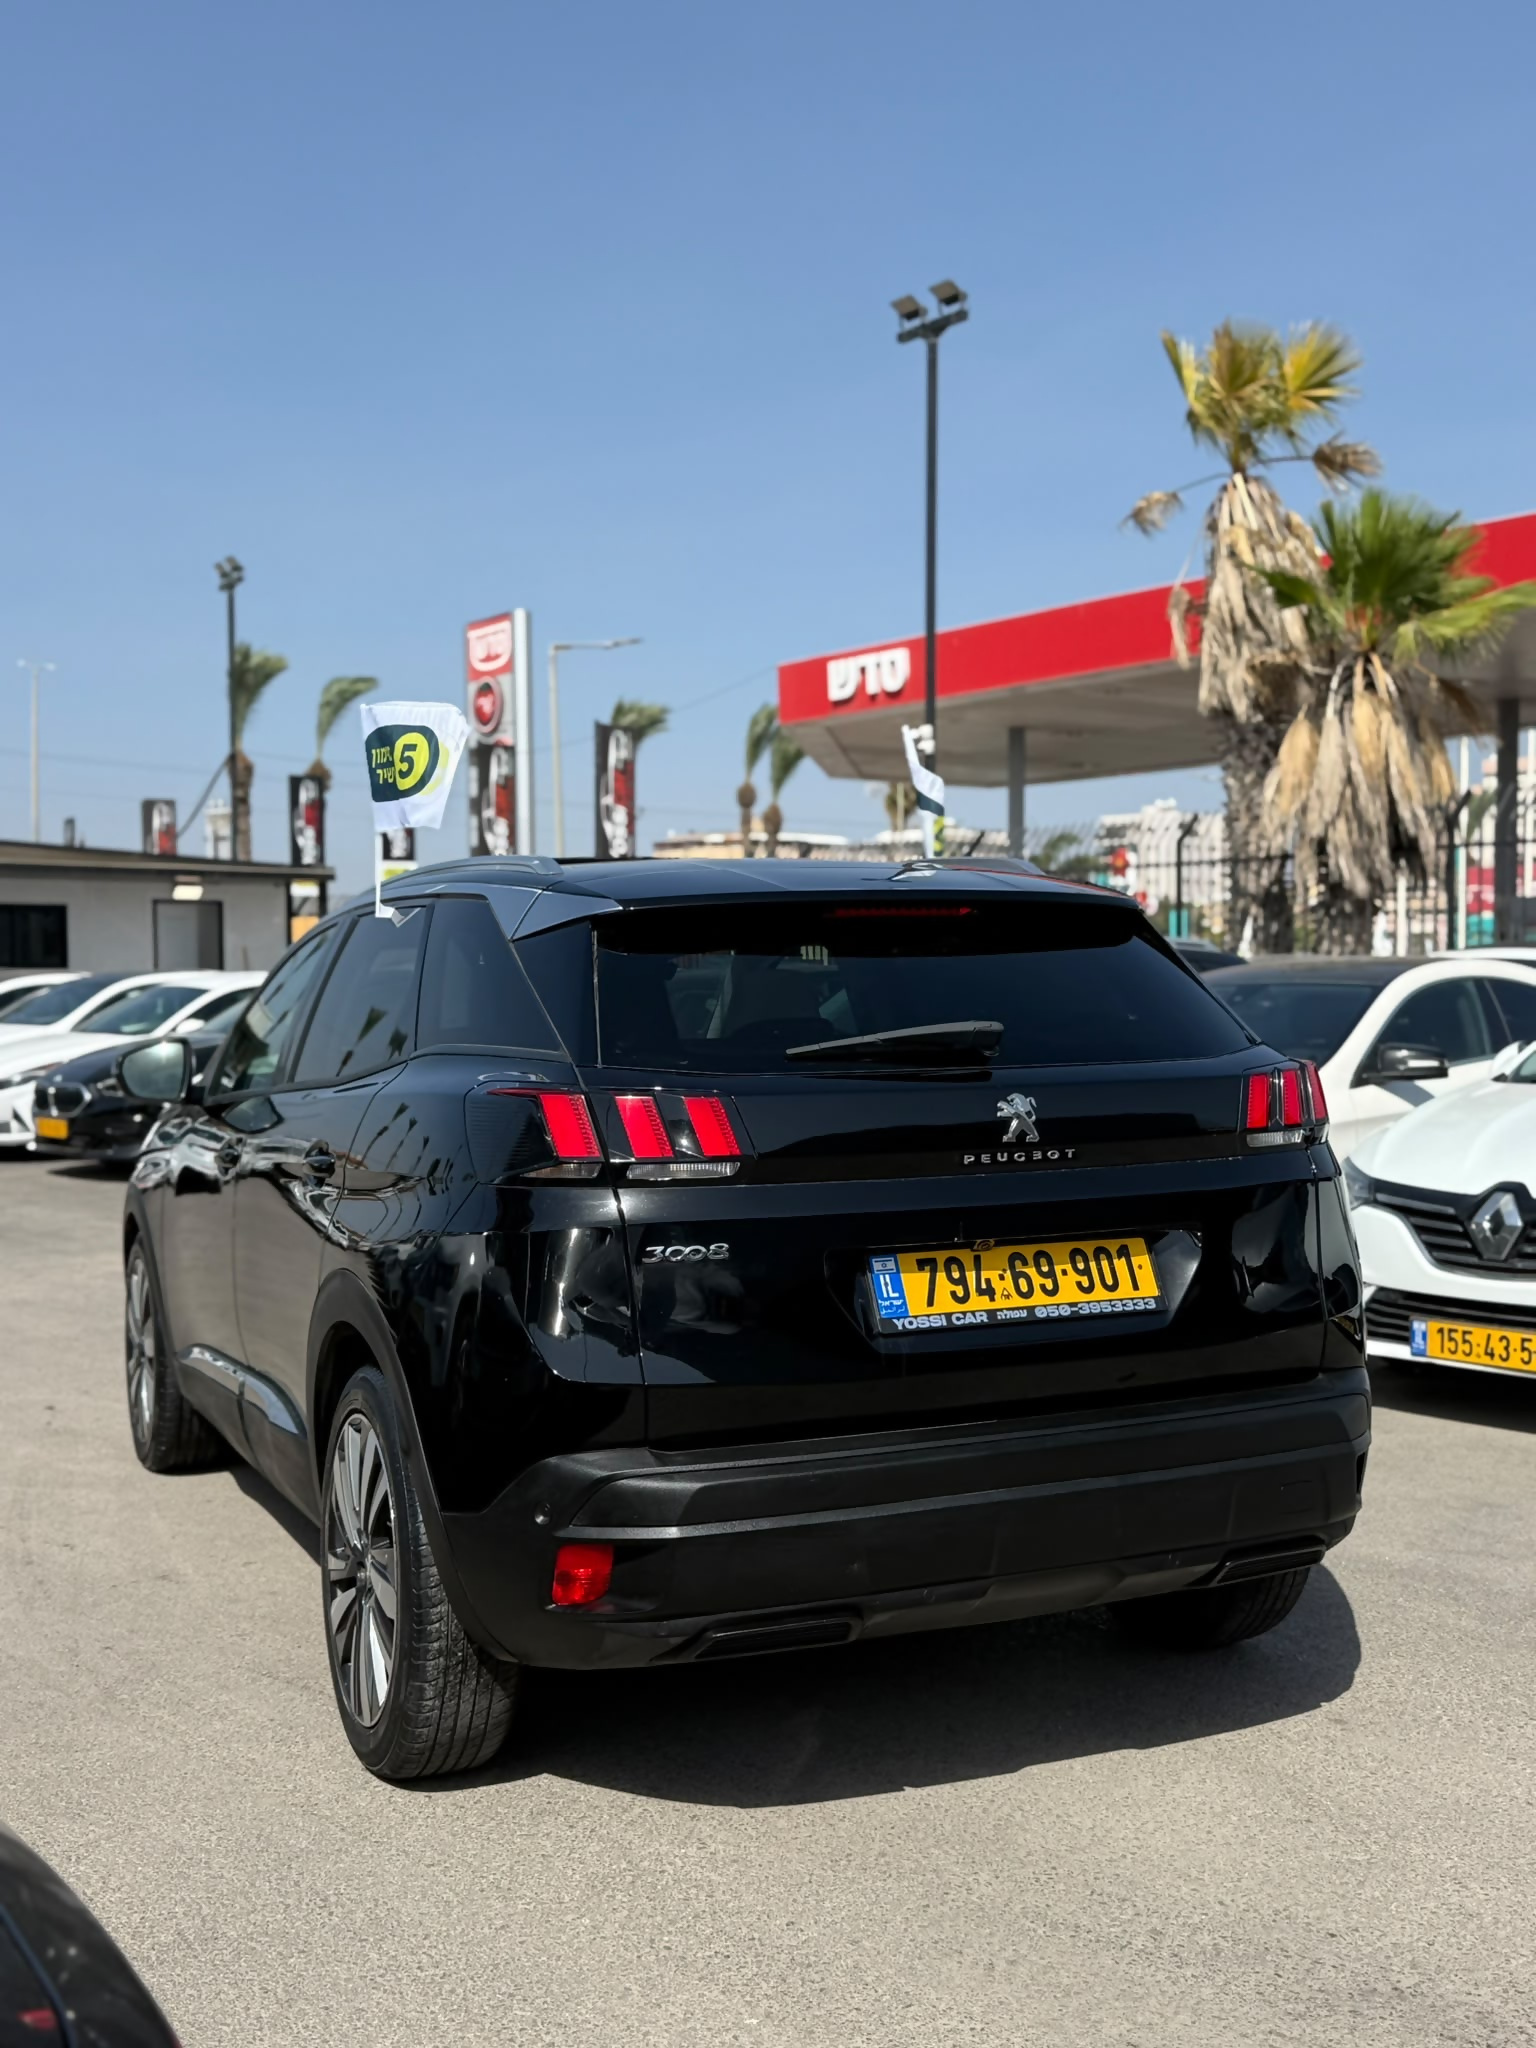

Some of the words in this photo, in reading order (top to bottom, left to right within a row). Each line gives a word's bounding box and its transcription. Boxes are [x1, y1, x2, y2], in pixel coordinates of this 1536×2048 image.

[398, 744, 418, 780] 5
[963, 1148, 1076, 1165] PEUGEOT
[641, 1242, 730, 1264] 3008
[879, 1273, 900, 1298] IL
[892, 1314, 947, 1330] YOSSI
[951, 1311, 989, 1323] CAR
[1034, 1298, 1157, 1318] 050-3953333
